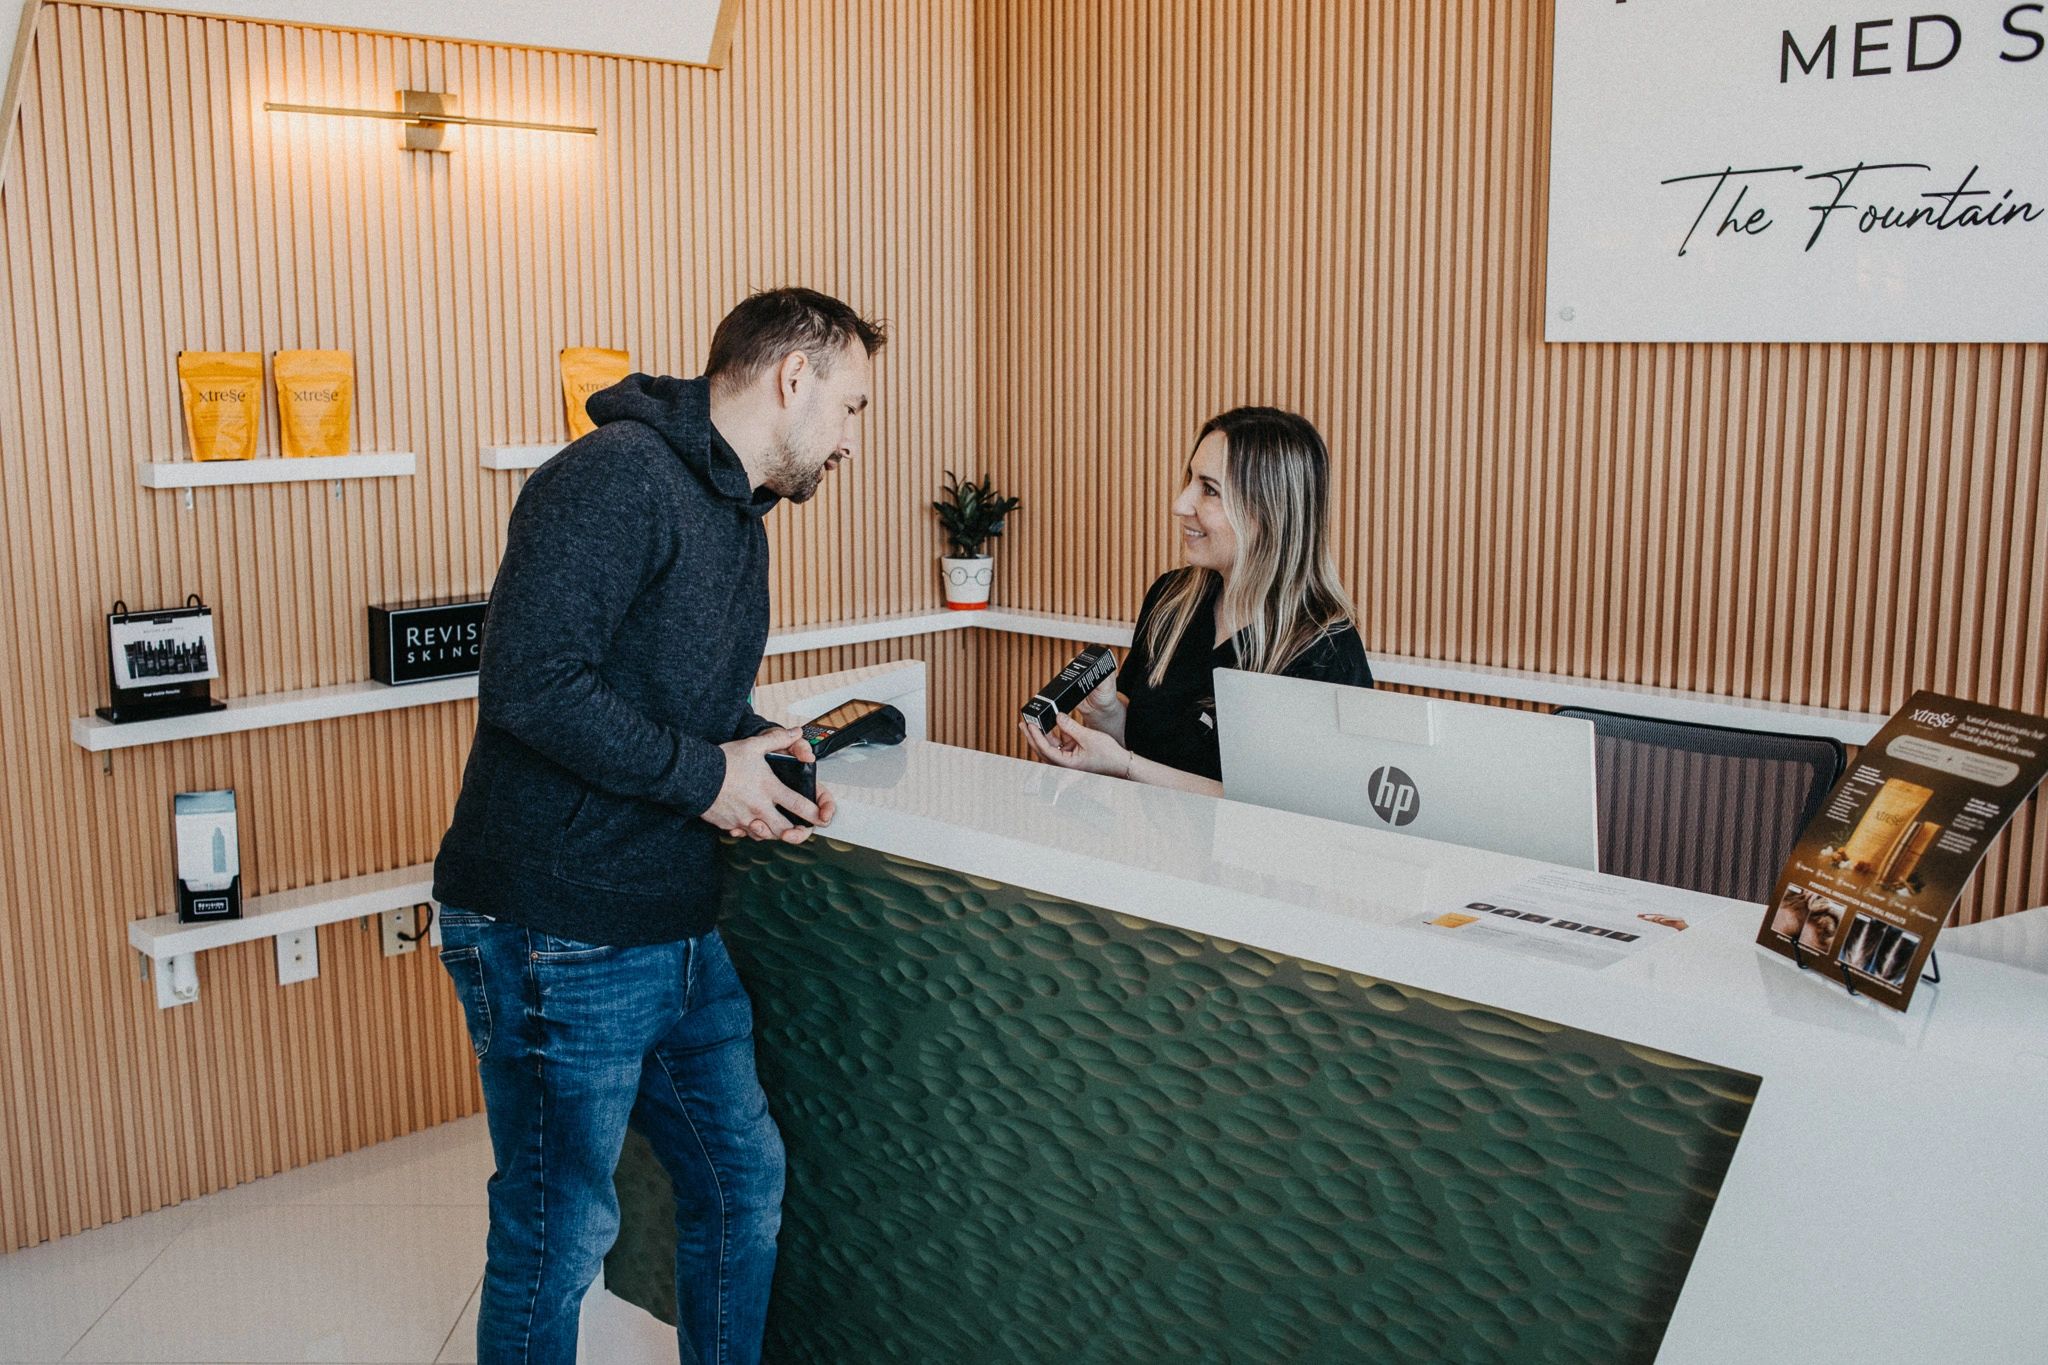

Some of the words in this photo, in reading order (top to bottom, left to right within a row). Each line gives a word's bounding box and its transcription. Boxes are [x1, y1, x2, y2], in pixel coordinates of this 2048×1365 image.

[1780, 14, 1962, 84] MED
[1660, 165, 1804, 258] The
[1804, 161, 2045, 253] Fountain
[1372, 764, 1417, 826] hp
